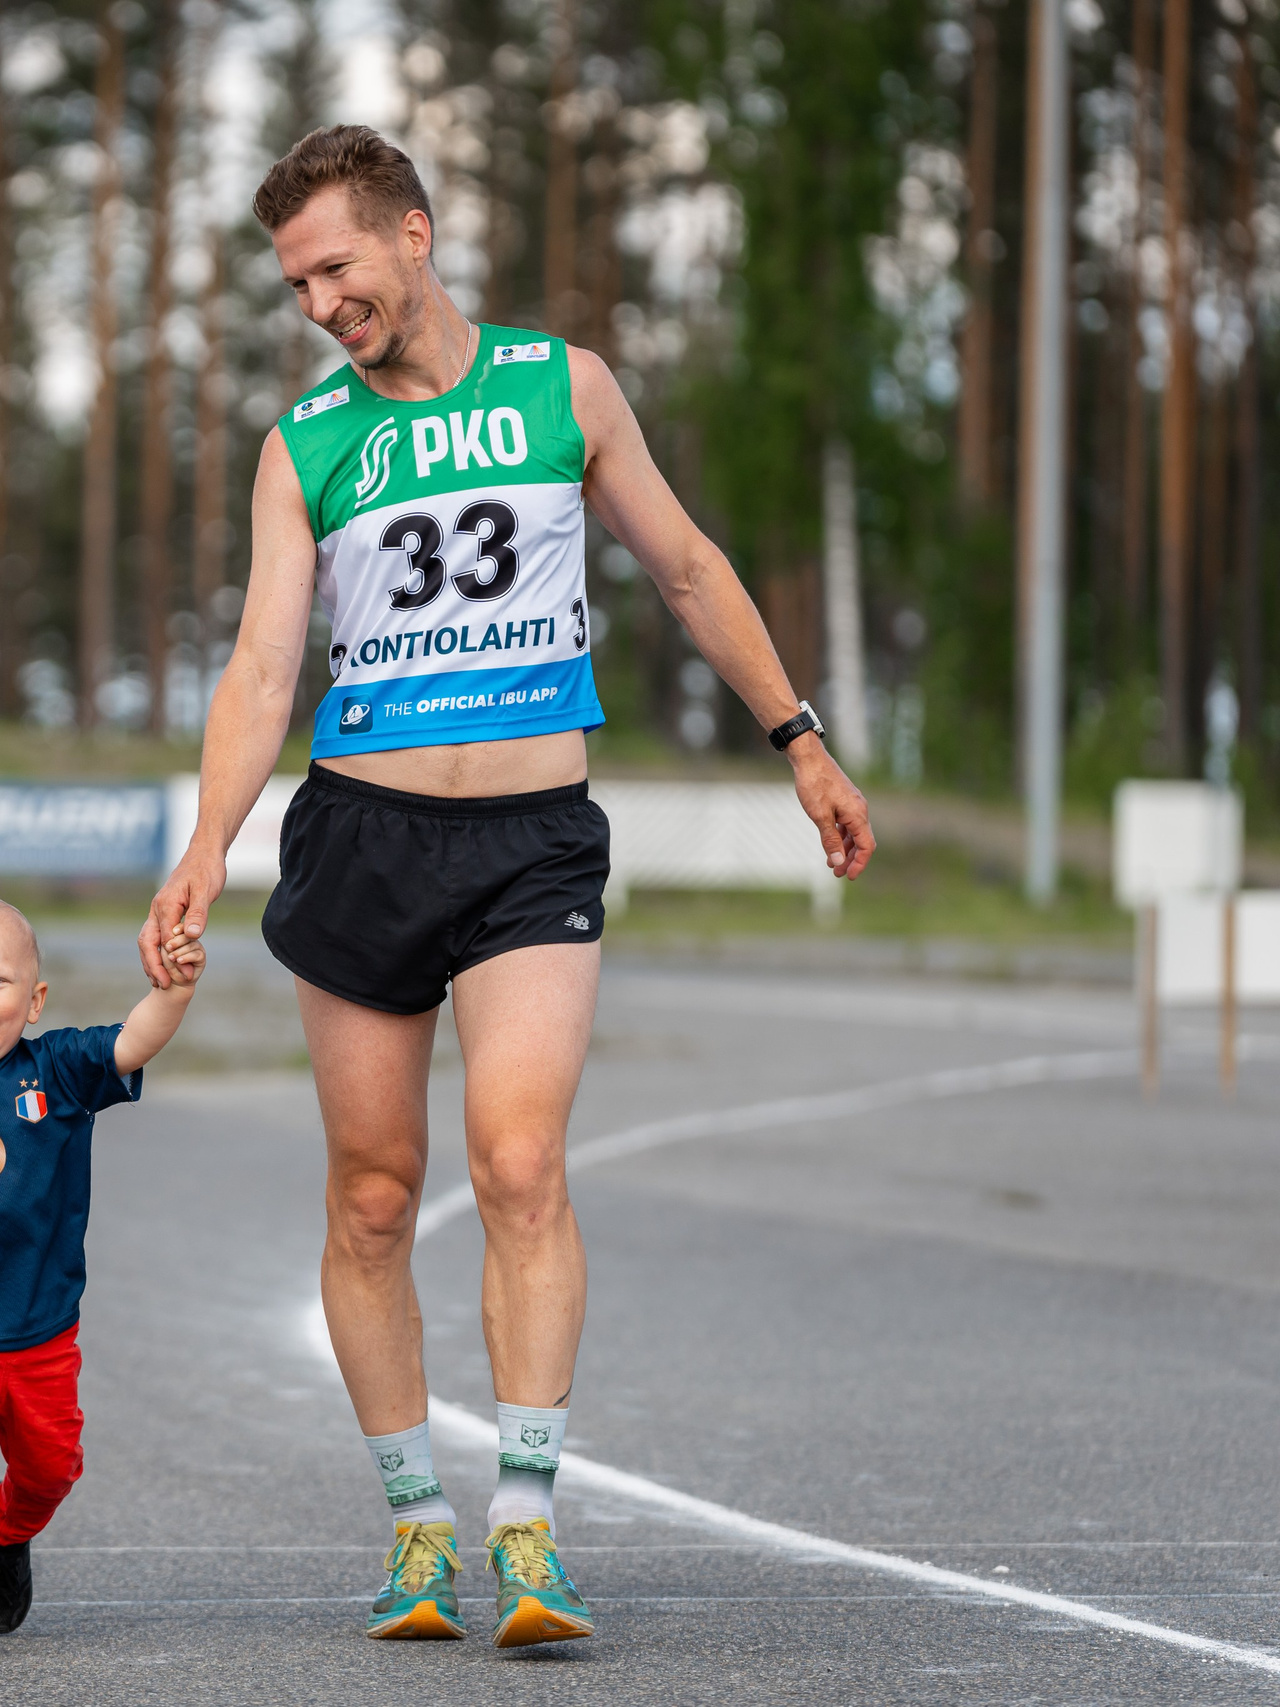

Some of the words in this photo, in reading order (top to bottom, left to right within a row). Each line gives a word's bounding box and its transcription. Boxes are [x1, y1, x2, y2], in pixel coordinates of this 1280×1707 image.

[411, 406, 528, 478] PKO
[378, 498, 521, 612] 33
[384, 702, 413, 717] THE
[416, 693, 496, 714] OFFICIAL
[499, 690, 527, 706] IBU
[529, 686, 558, 702] APP
